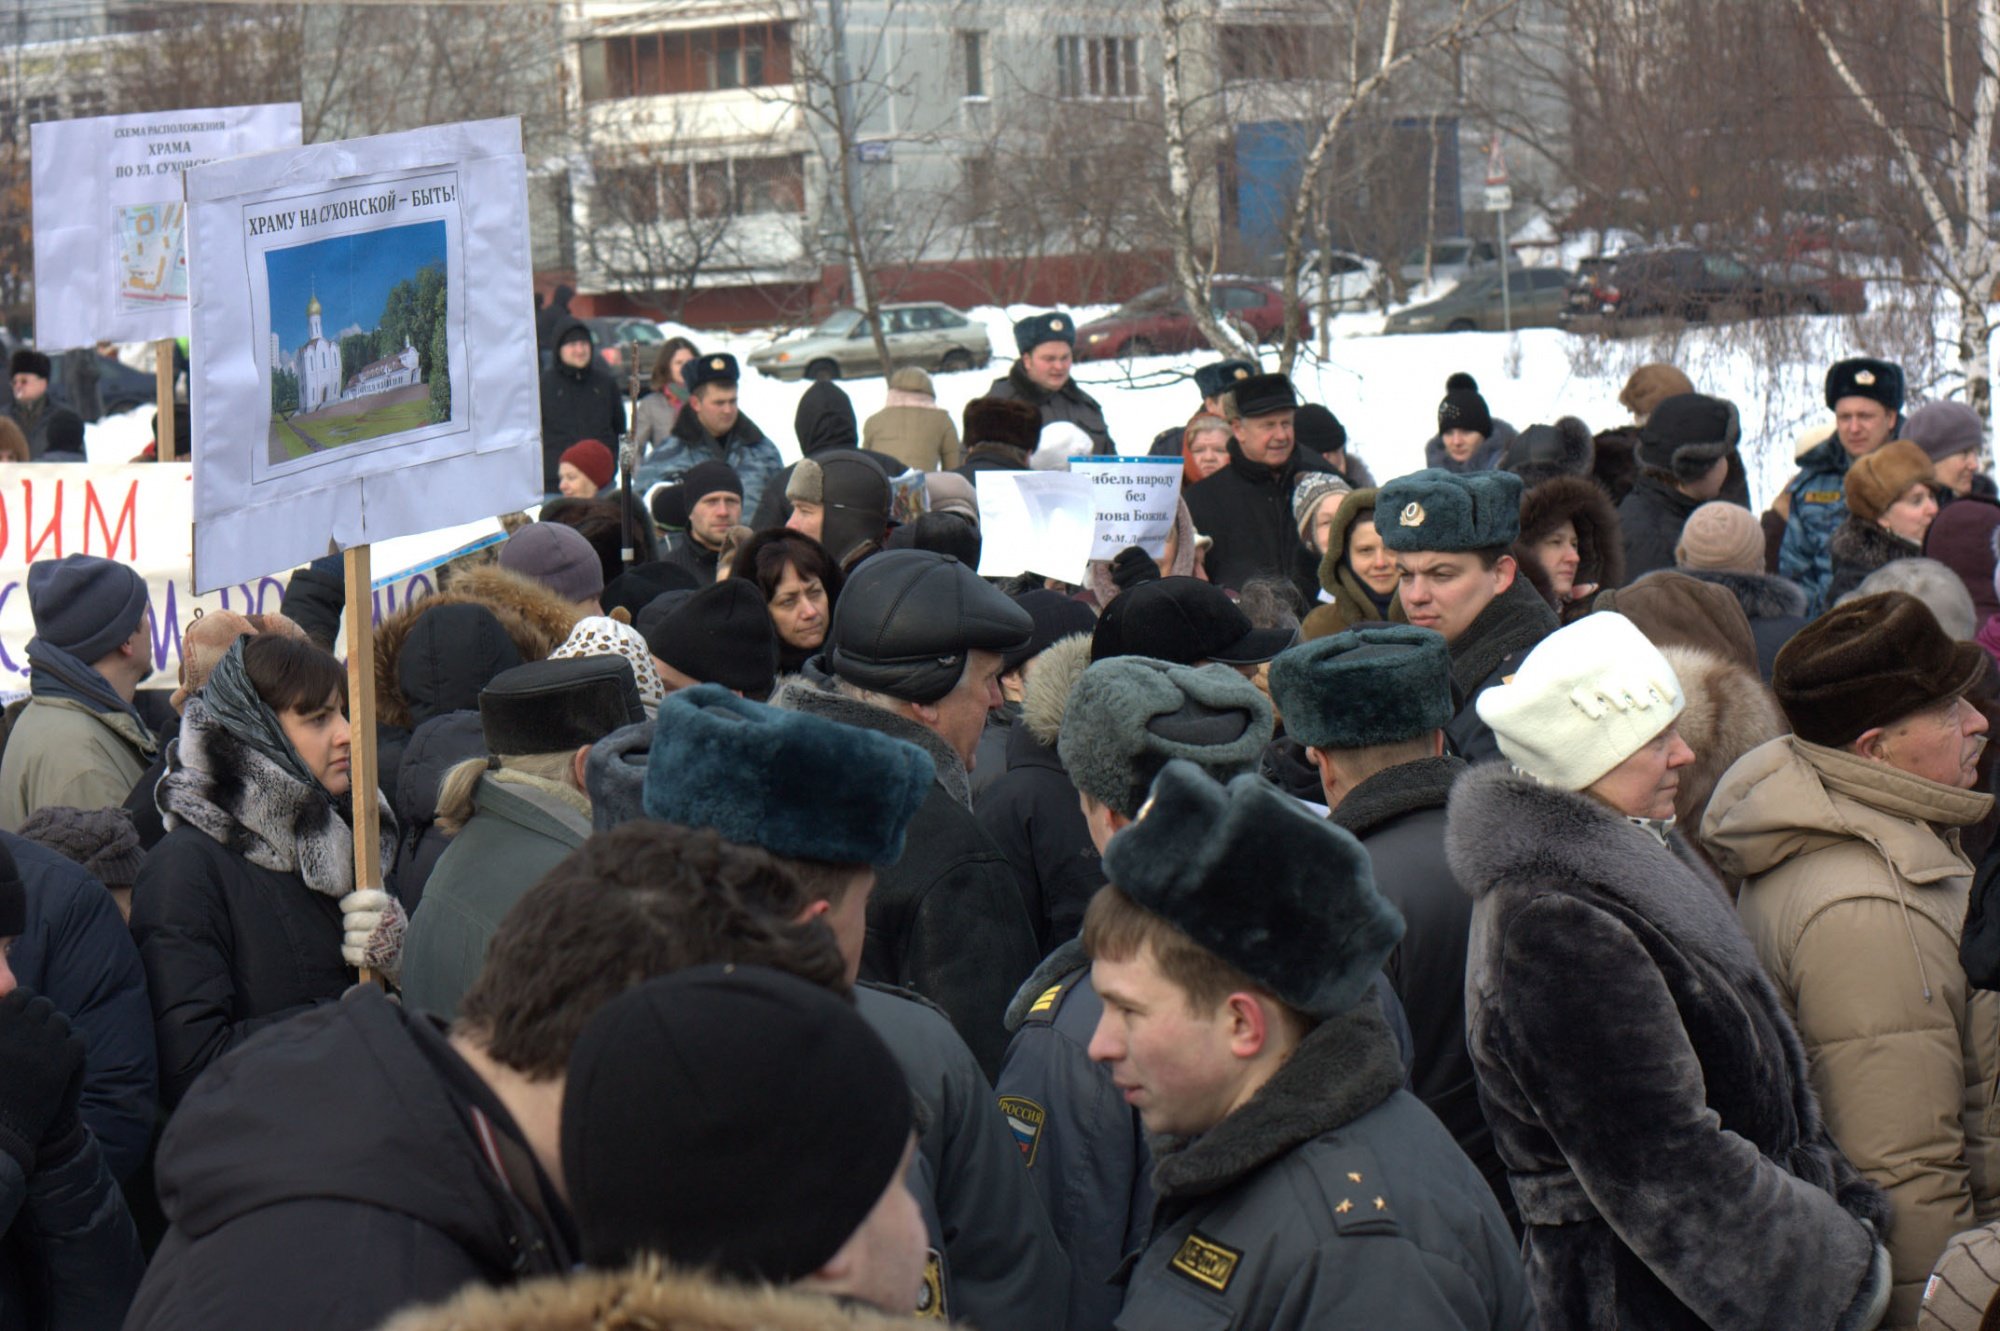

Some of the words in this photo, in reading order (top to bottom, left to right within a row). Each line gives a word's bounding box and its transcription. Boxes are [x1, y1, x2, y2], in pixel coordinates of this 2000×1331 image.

[114, 127, 146, 138] СХЕМА
[147, 121, 226, 135] РАСПОЛОЖЕНИЯ
[148, 141, 192, 156] ХРАМА
[116, 165, 133, 178] ПО
[136, 163, 154, 176] УЛ.
[249, 211, 296, 236] ХРАМУ
[300, 208, 318, 227] НА
[319, 190, 396, 222] СУХОНСКОЙ
[412, 185, 456, 207] БЫТЬ!
[1136, 475, 1175, 488] народу
[1125, 490, 1146, 502] без
[0, 479, 138, 563] ИМ
[1095, 511, 1130, 521] лова
[1001, 1101, 1042, 1124] РОССИЯ
